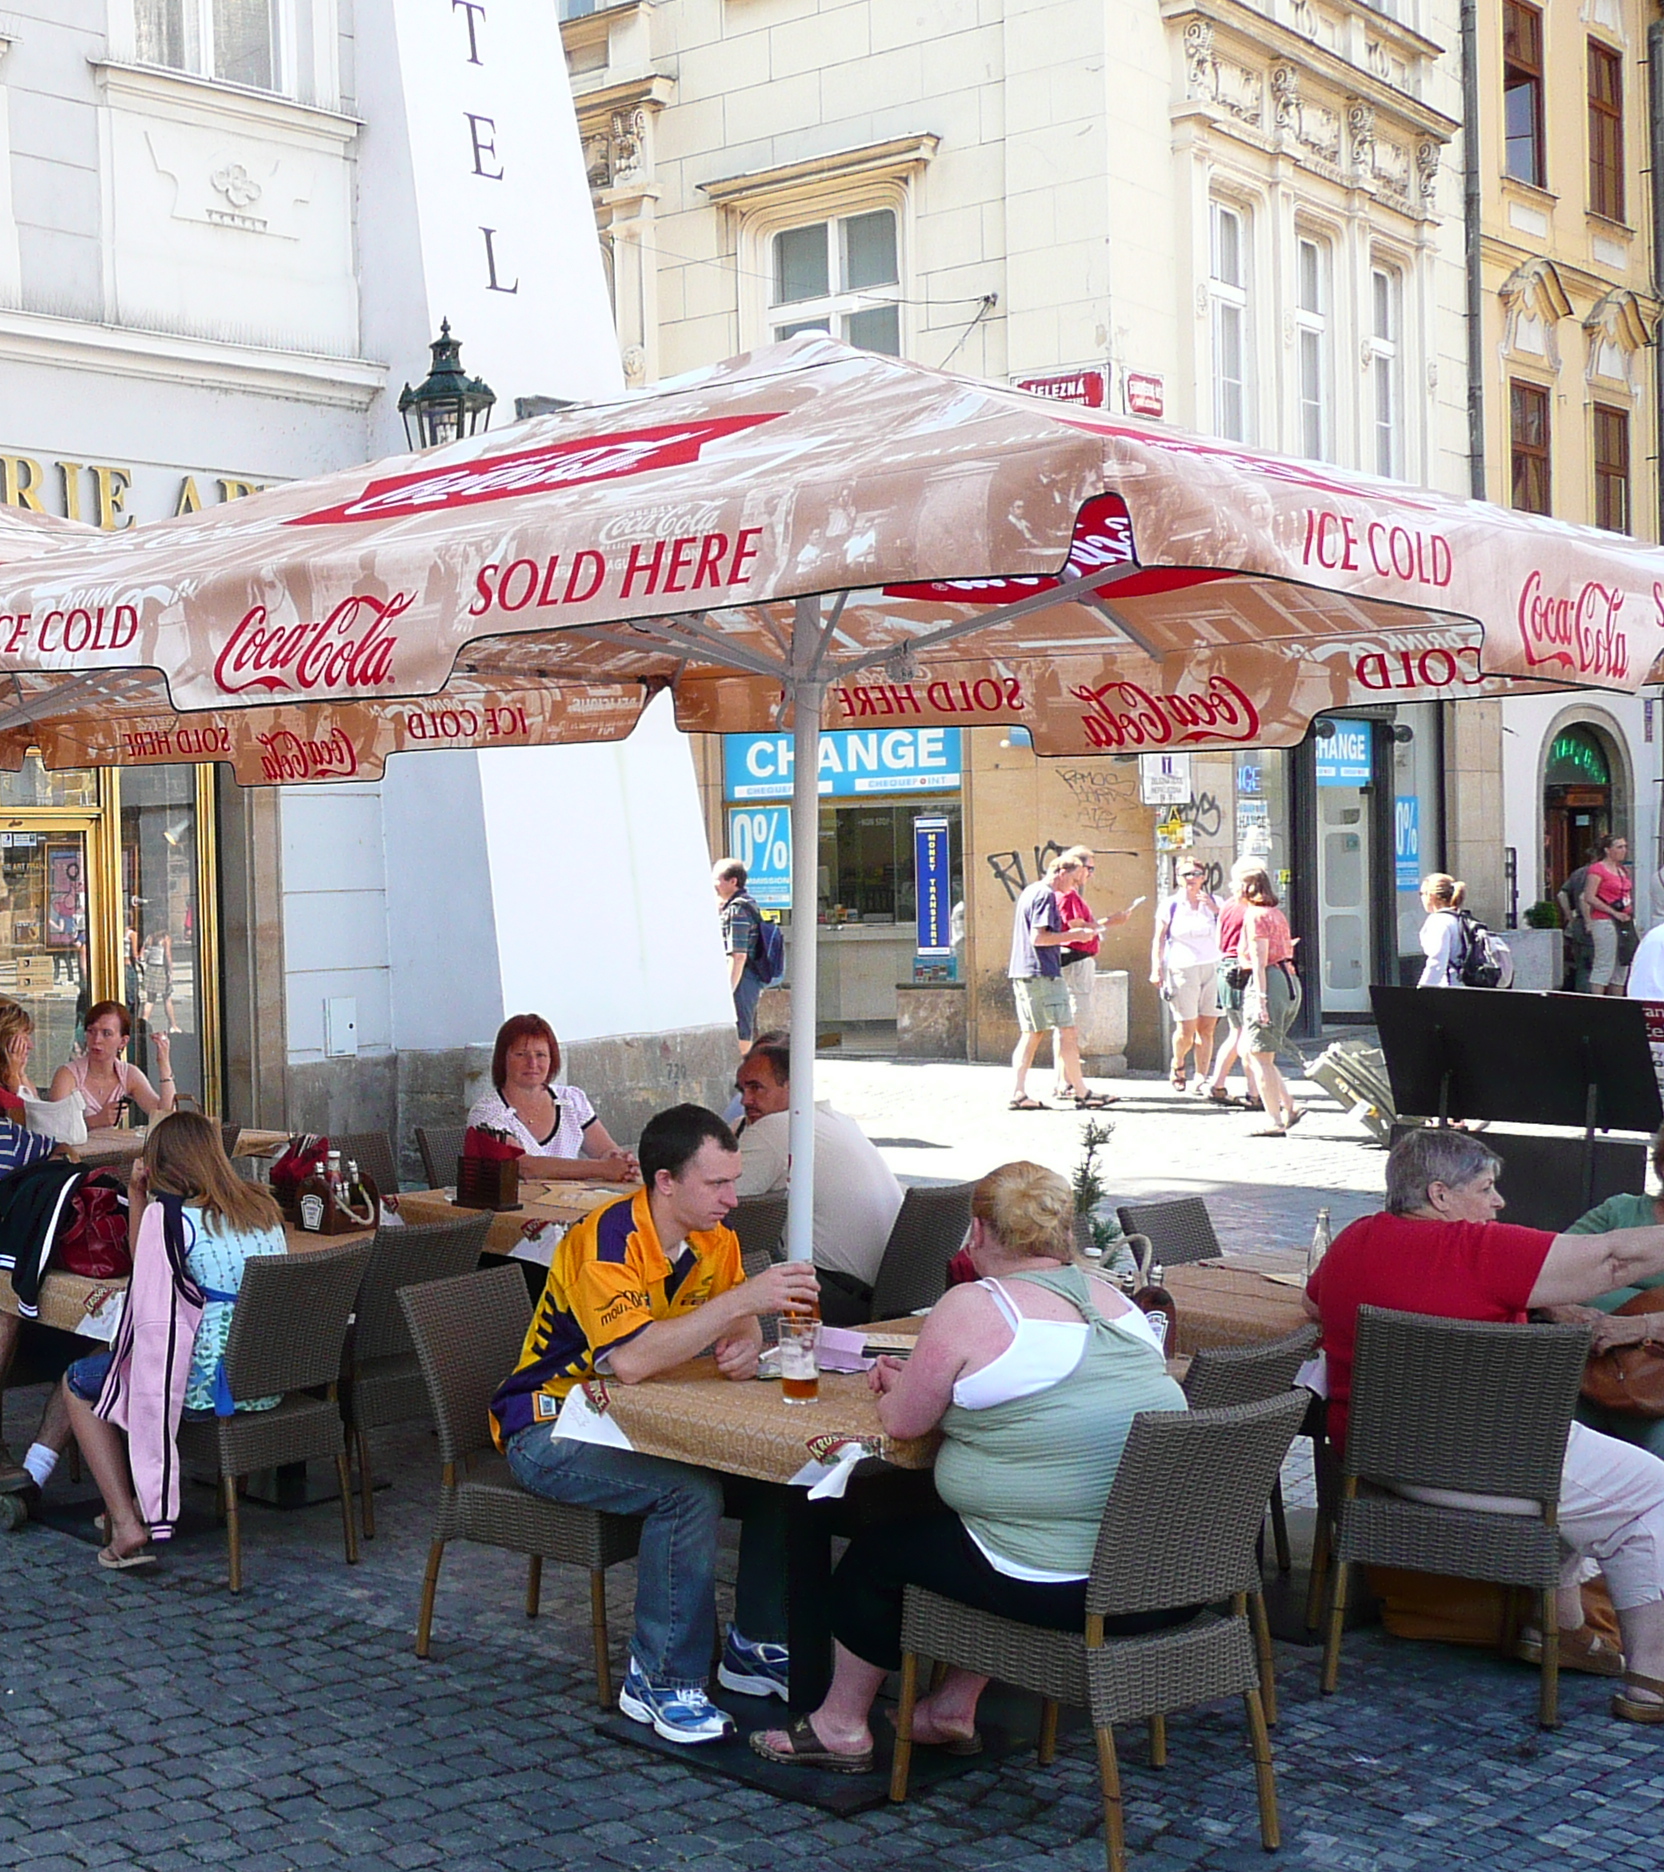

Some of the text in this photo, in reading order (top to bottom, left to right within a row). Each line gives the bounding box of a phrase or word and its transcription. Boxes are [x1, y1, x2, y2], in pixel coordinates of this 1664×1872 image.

[468, 527, 764, 615] SOLD HERE
[1302, 509, 1453, 587] ICE COLD
[37, 604, 138, 652] COLD
[214, 590, 419, 695] Coca-Cola
[1518, 569, 1630, 680] Coca-Cola
[745, 729, 947, 778] CHANGE
[732, 811, 788, 872] 0%
[1395, 801, 1418, 856] 0%
[927, 833, 938, 946] MONEY TRANSFERS
